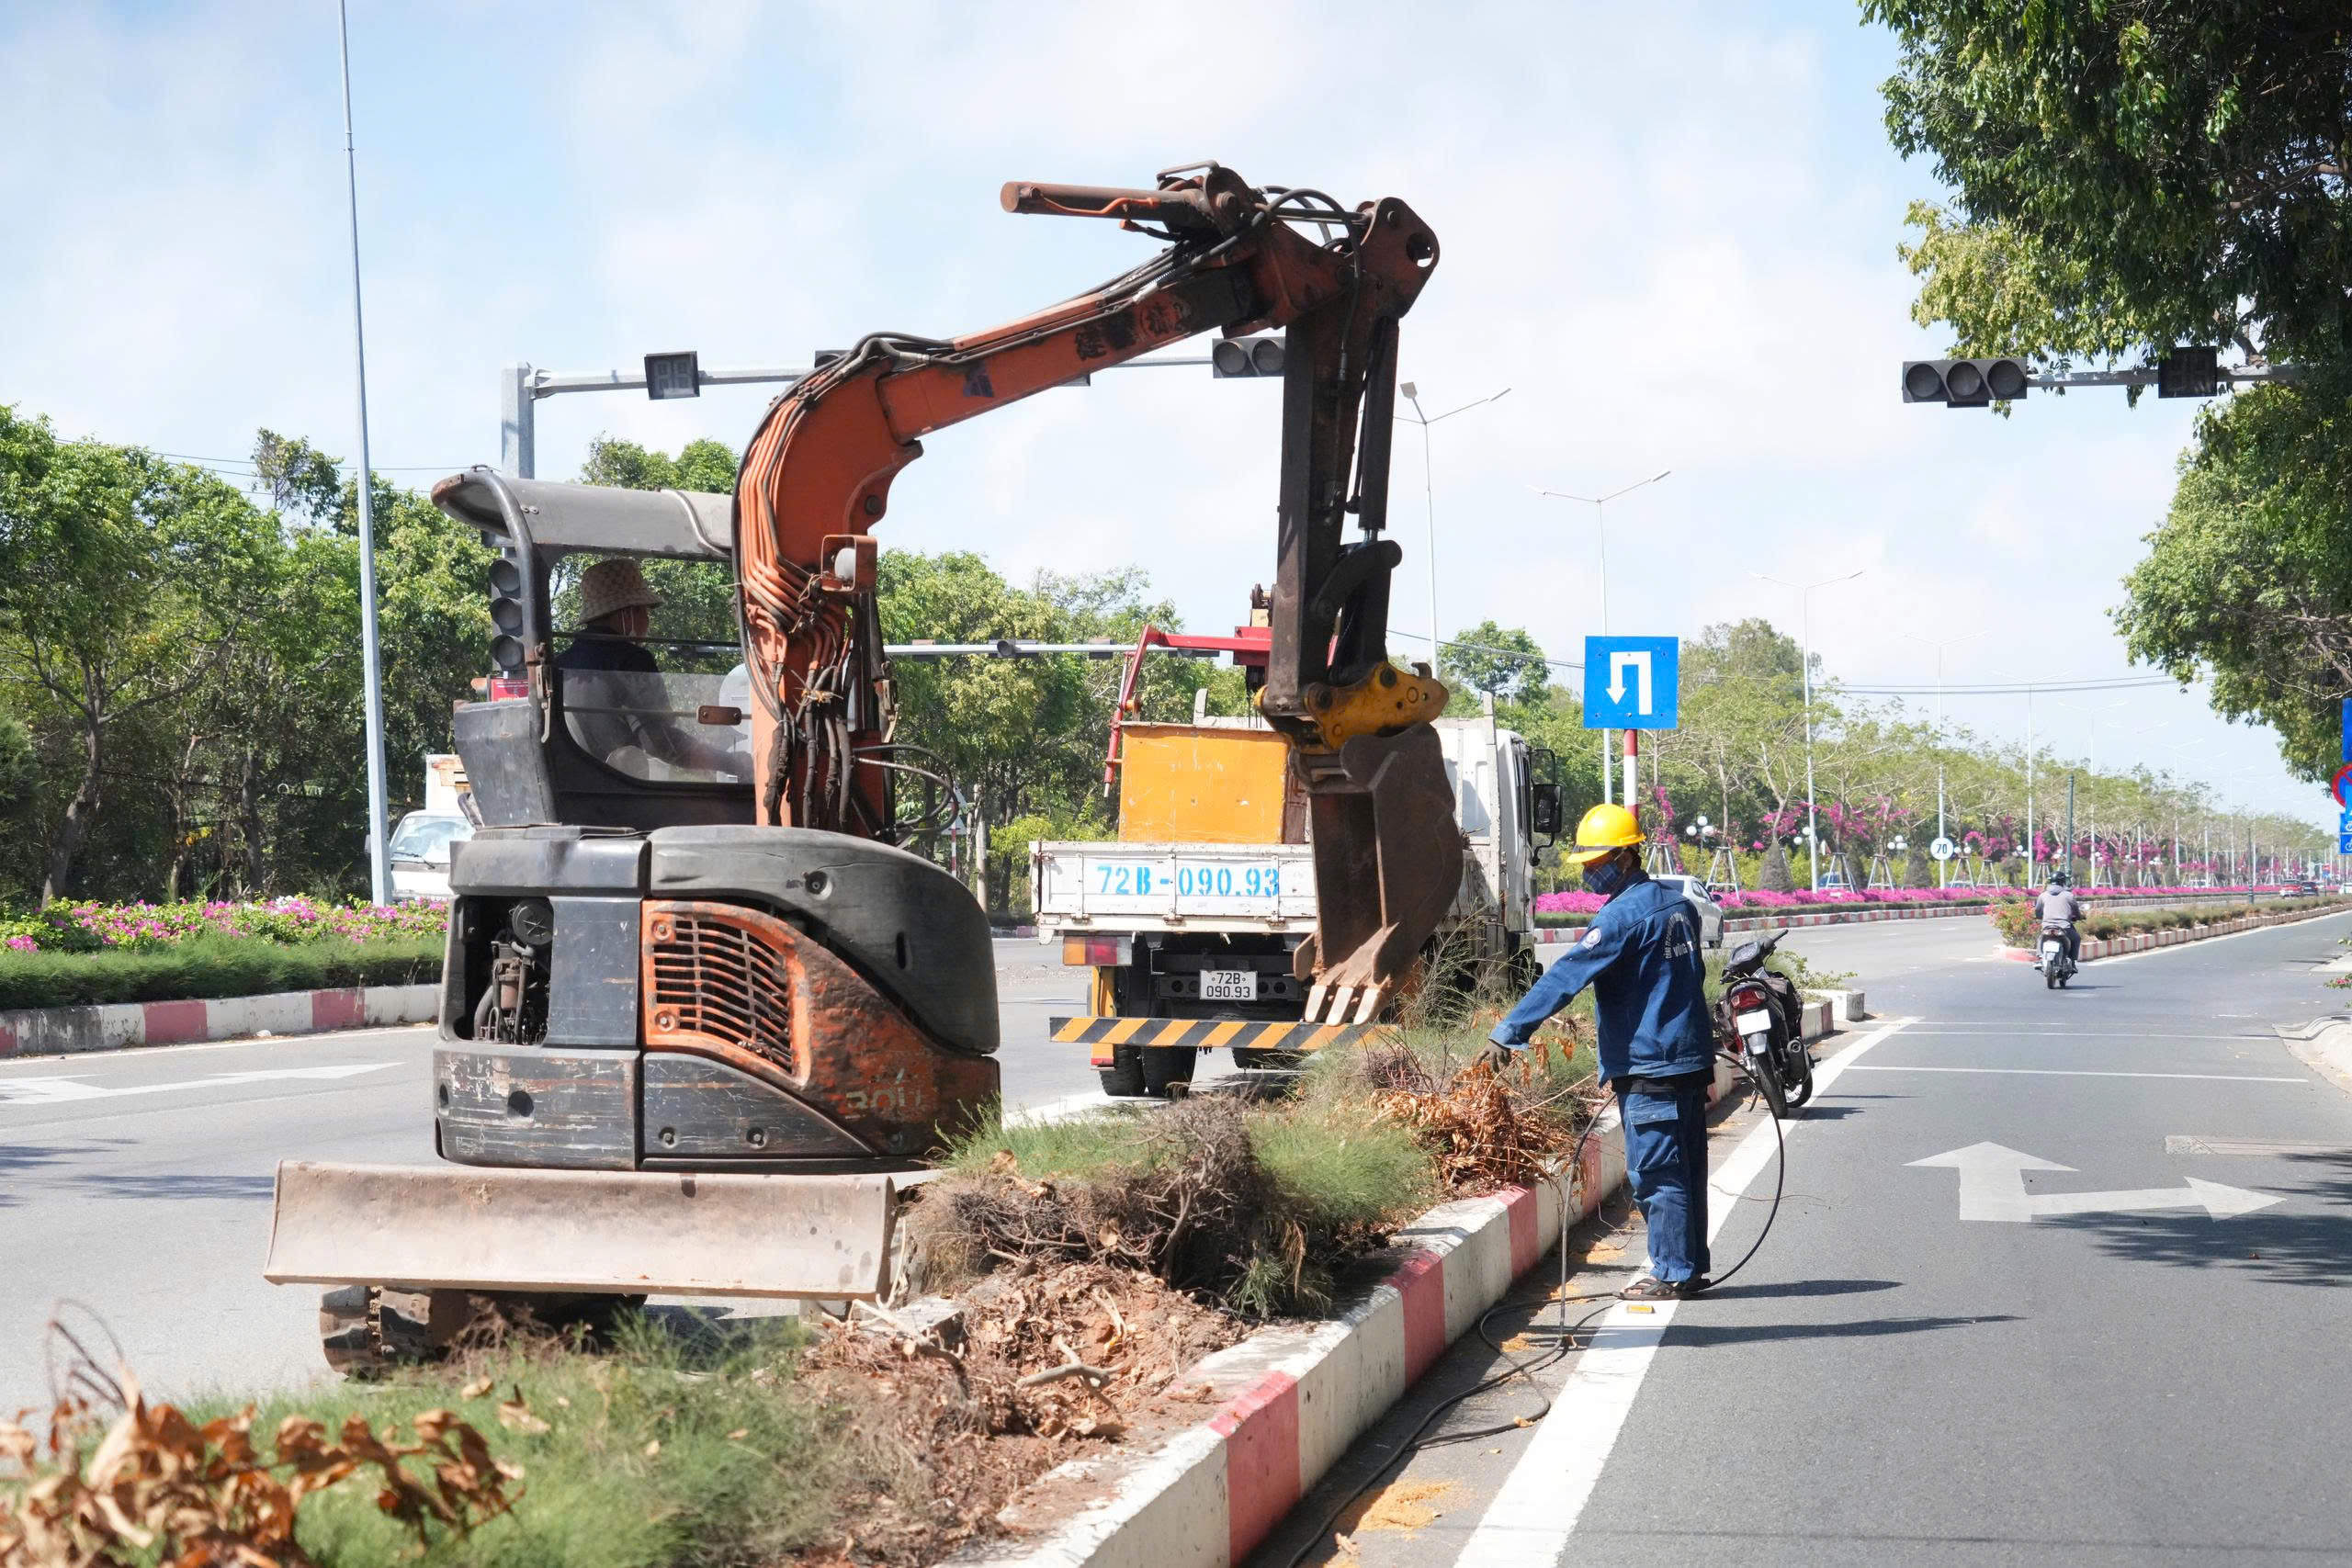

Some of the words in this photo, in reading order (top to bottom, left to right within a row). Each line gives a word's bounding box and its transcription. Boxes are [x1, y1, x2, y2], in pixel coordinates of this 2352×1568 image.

[1936, 843, 1948, 854] 70
[1216, 972, 1240, 985] 72B
[1206, 986, 1250, 998] 090.93
